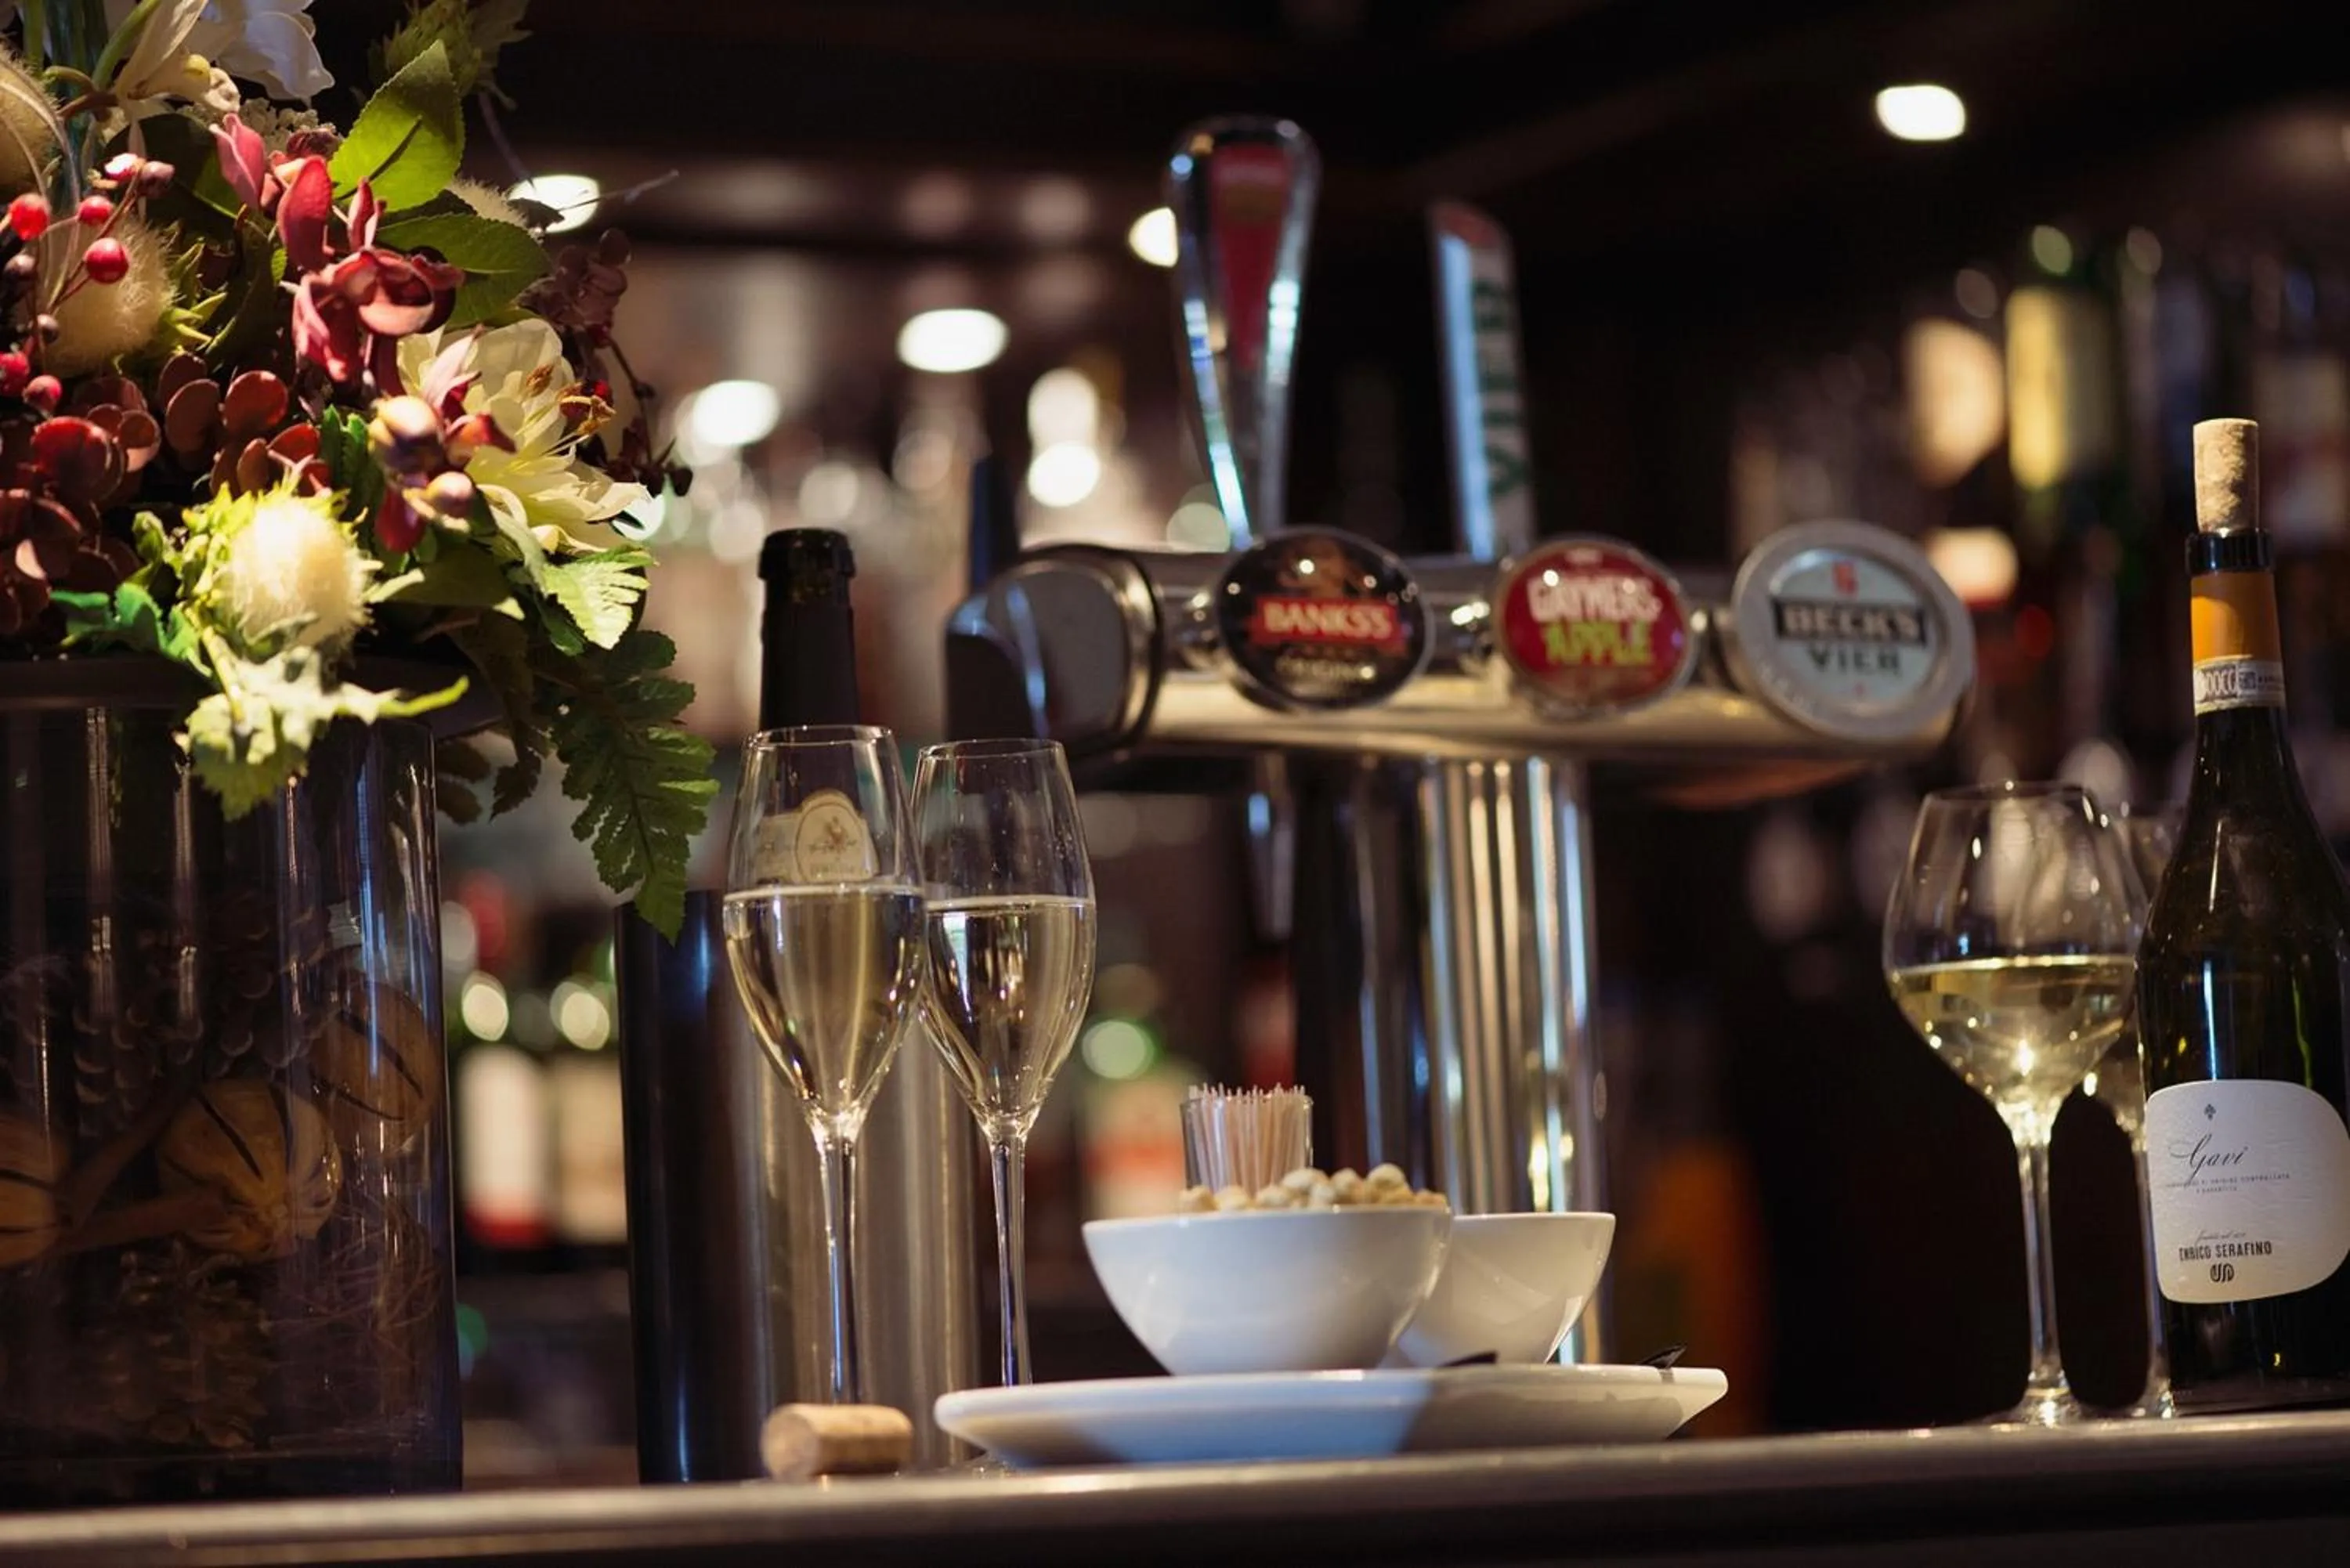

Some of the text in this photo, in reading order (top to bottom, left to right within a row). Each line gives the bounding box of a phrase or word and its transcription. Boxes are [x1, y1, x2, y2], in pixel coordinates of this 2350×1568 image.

[1542, 619, 1654, 664] APPLE
[1806, 641, 1904, 678] VIER
[2167, 1133, 2250, 1188] Gavi
[2178, 1240, 2272, 1262] ENRICO SERAFINO
